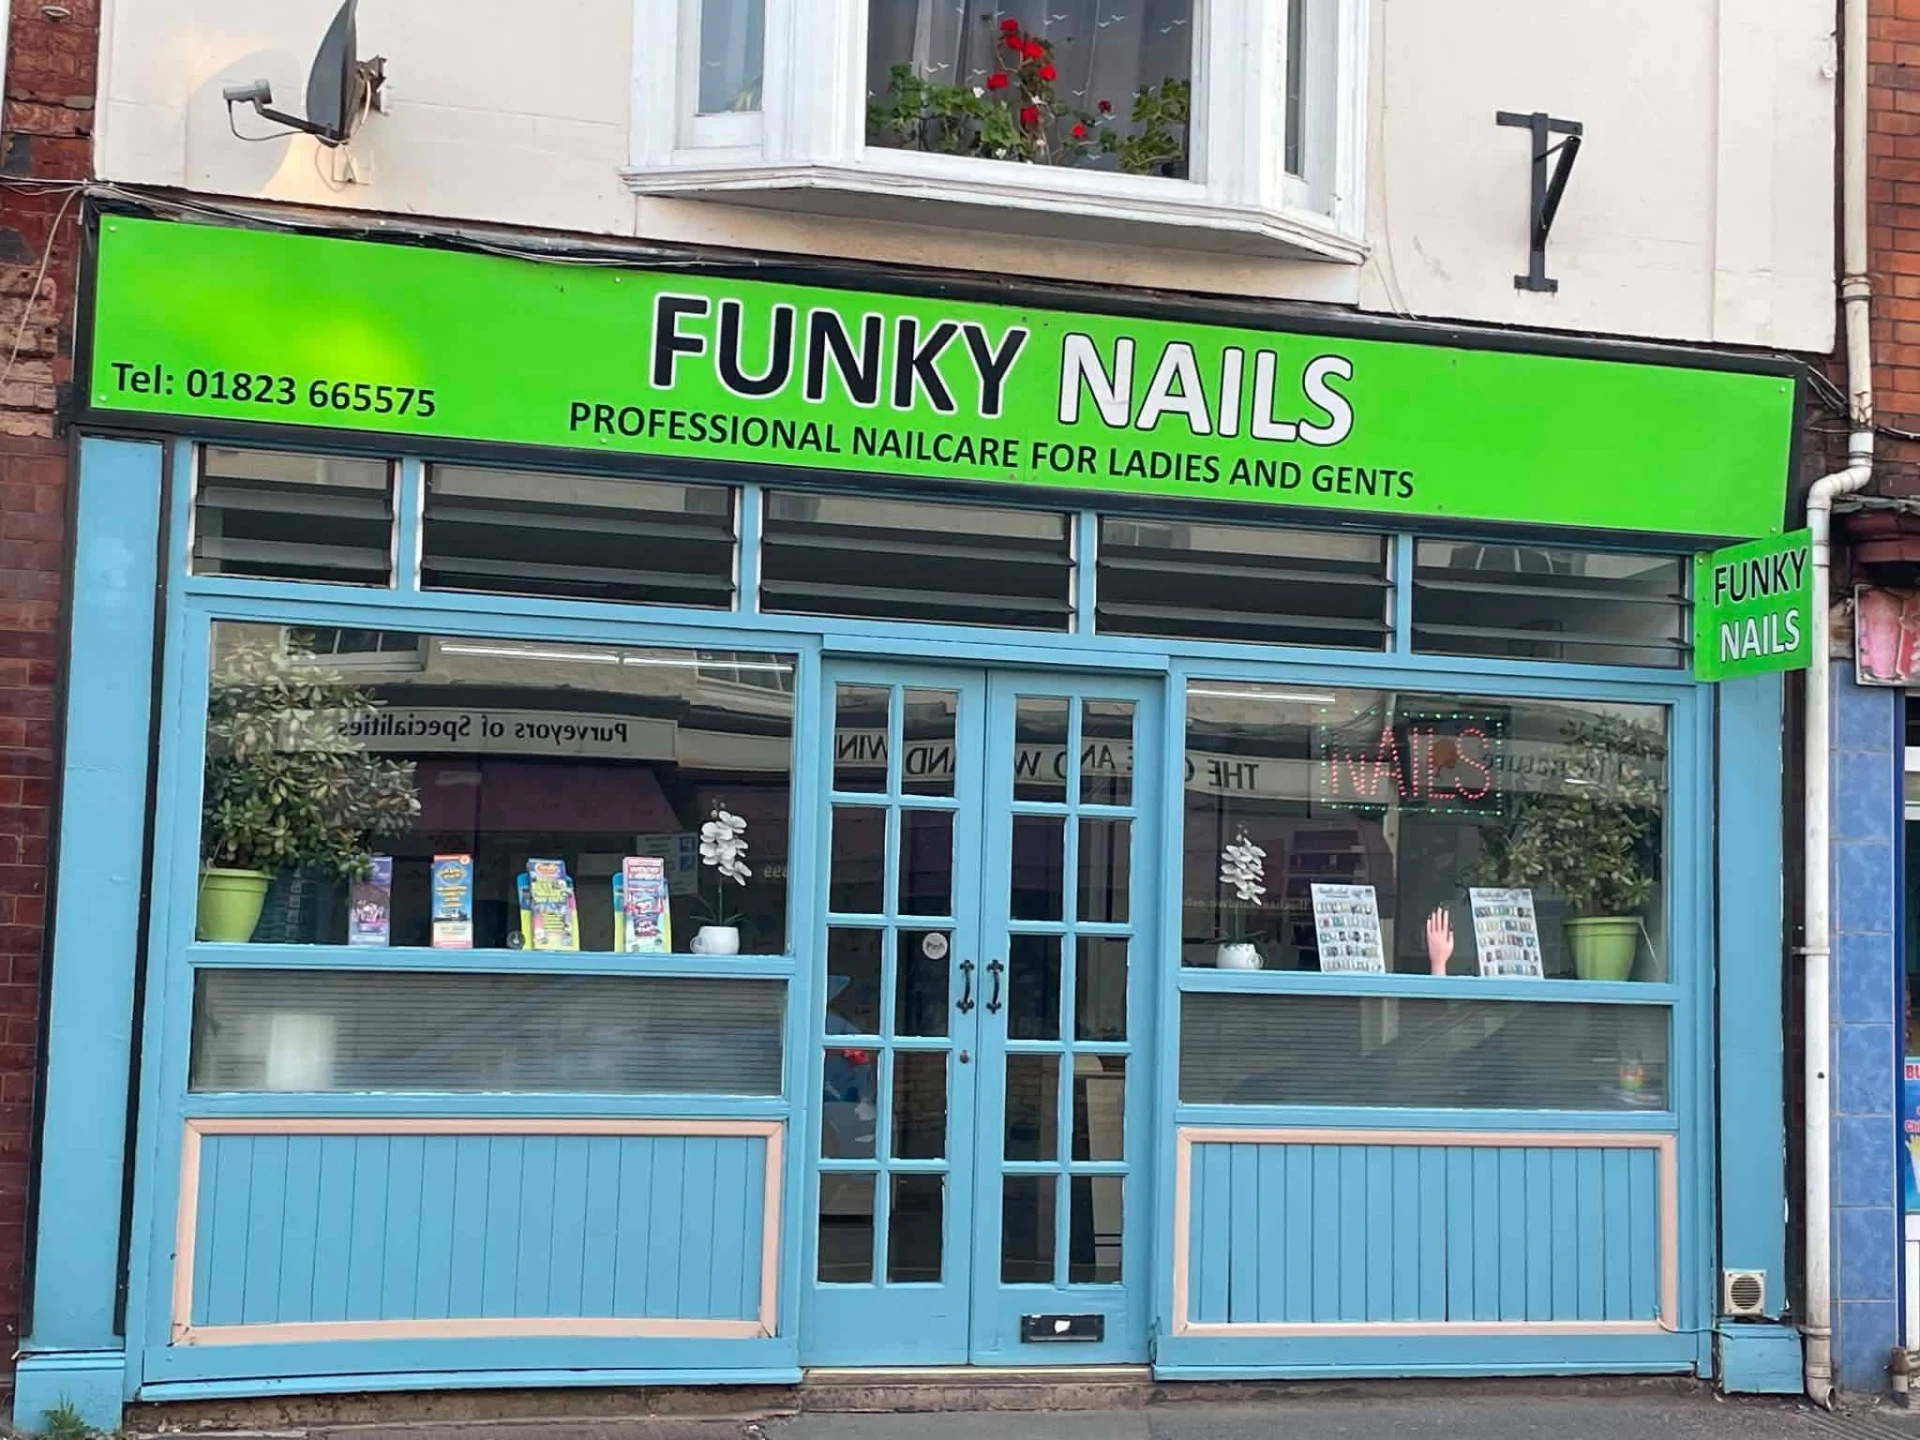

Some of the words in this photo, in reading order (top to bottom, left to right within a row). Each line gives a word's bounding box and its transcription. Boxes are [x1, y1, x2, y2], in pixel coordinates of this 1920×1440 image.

[111, 362, 173, 396] Tel:
[186, 367, 296, 405] 01823
[308, 379, 437, 418] 665575
[649, 291, 1030, 422] FUNKY
[1056, 331, 1354, 448] NAILS
[569, 401, 841, 454] PROFESSIONAL
[852, 426, 1020, 468] NAILCARE
[1031, 441, 1097, 475] FOR
[1108, 447, 1220, 484] LADIES
[1229, 457, 1301, 490] AND
[1311, 464, 1415, 499] GENTS
[1713, 547, 1808, 608] FUNKY
[1720, 607, 1801, 663] NAILS
[1331, 725, 1492, 801] NAILS
